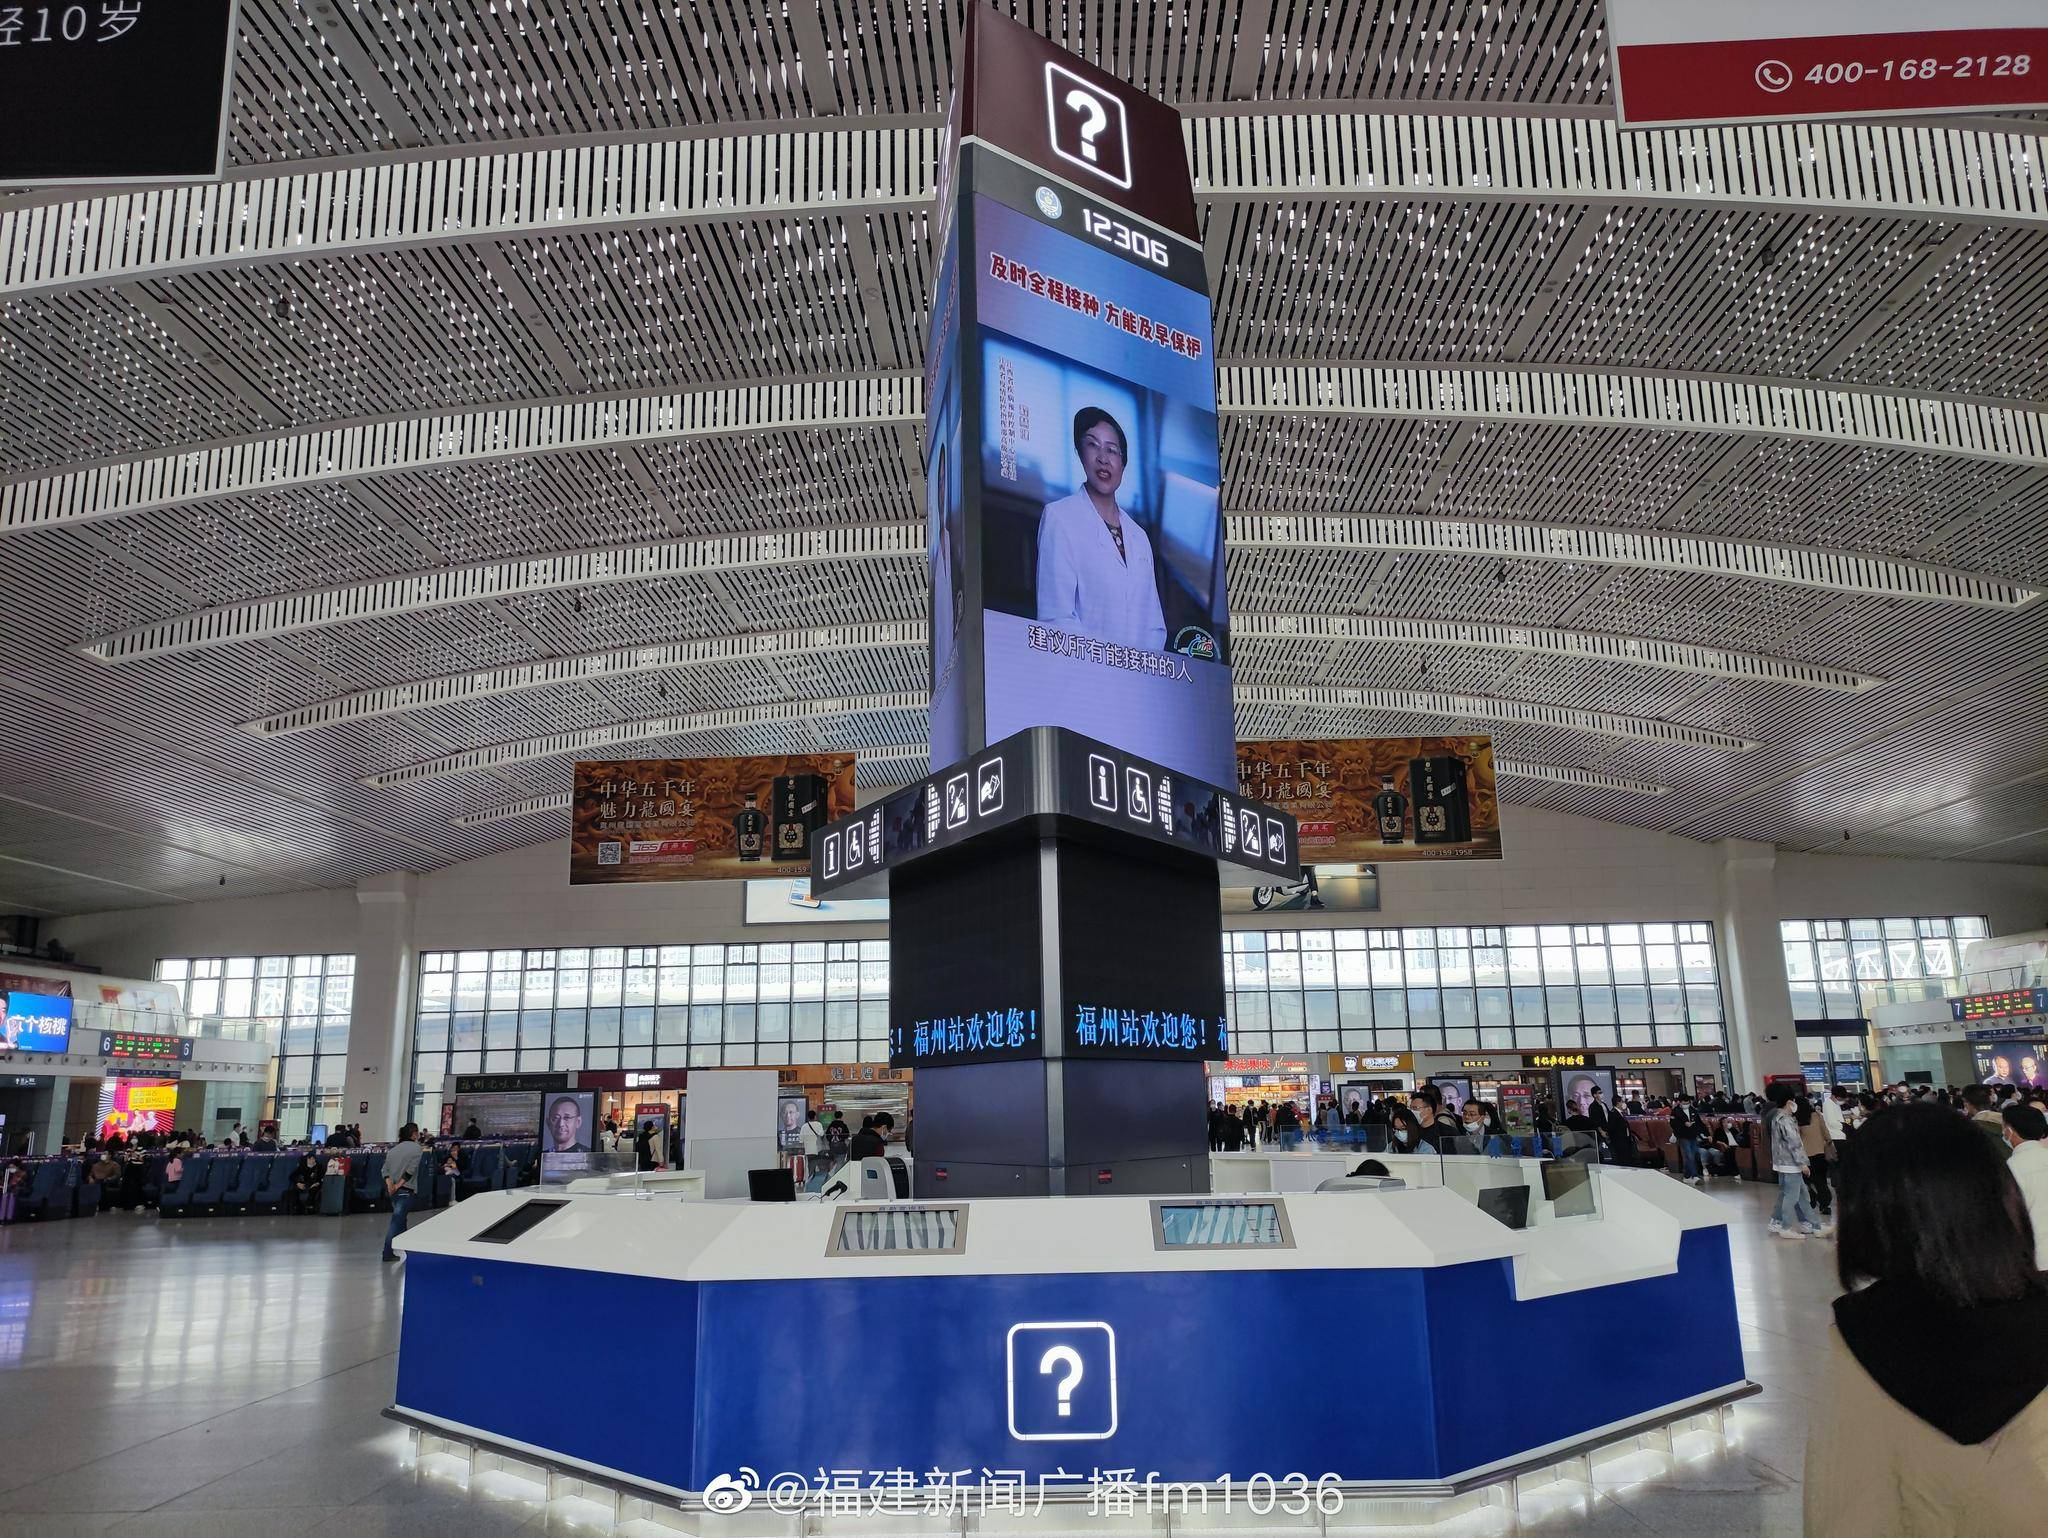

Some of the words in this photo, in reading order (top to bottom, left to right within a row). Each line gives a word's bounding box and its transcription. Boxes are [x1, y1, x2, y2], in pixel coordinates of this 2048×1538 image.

[1804, 54, 2031, 85] 400-168-2128
[1082, 208, 1169, 267] 12306
[990, 252, 1099, 318] 及时全程接种
[1104, 302, 1202, 360] 方能及早保护
[1028, 625, 1193, 682] 建议所有能接种的人
[1237, 760, 1331, 779] 中华五千年
[600, 780, 696, 799] 中华五千年
[1954, 1003, 1961, 1016] 7
[2036, 994, 2044, 1007] 7
[103, 1037, 111, 1051] 6
[183, 1043, 190, 1056] 6
[831, 1067, 873, 1081] 煌上煌
